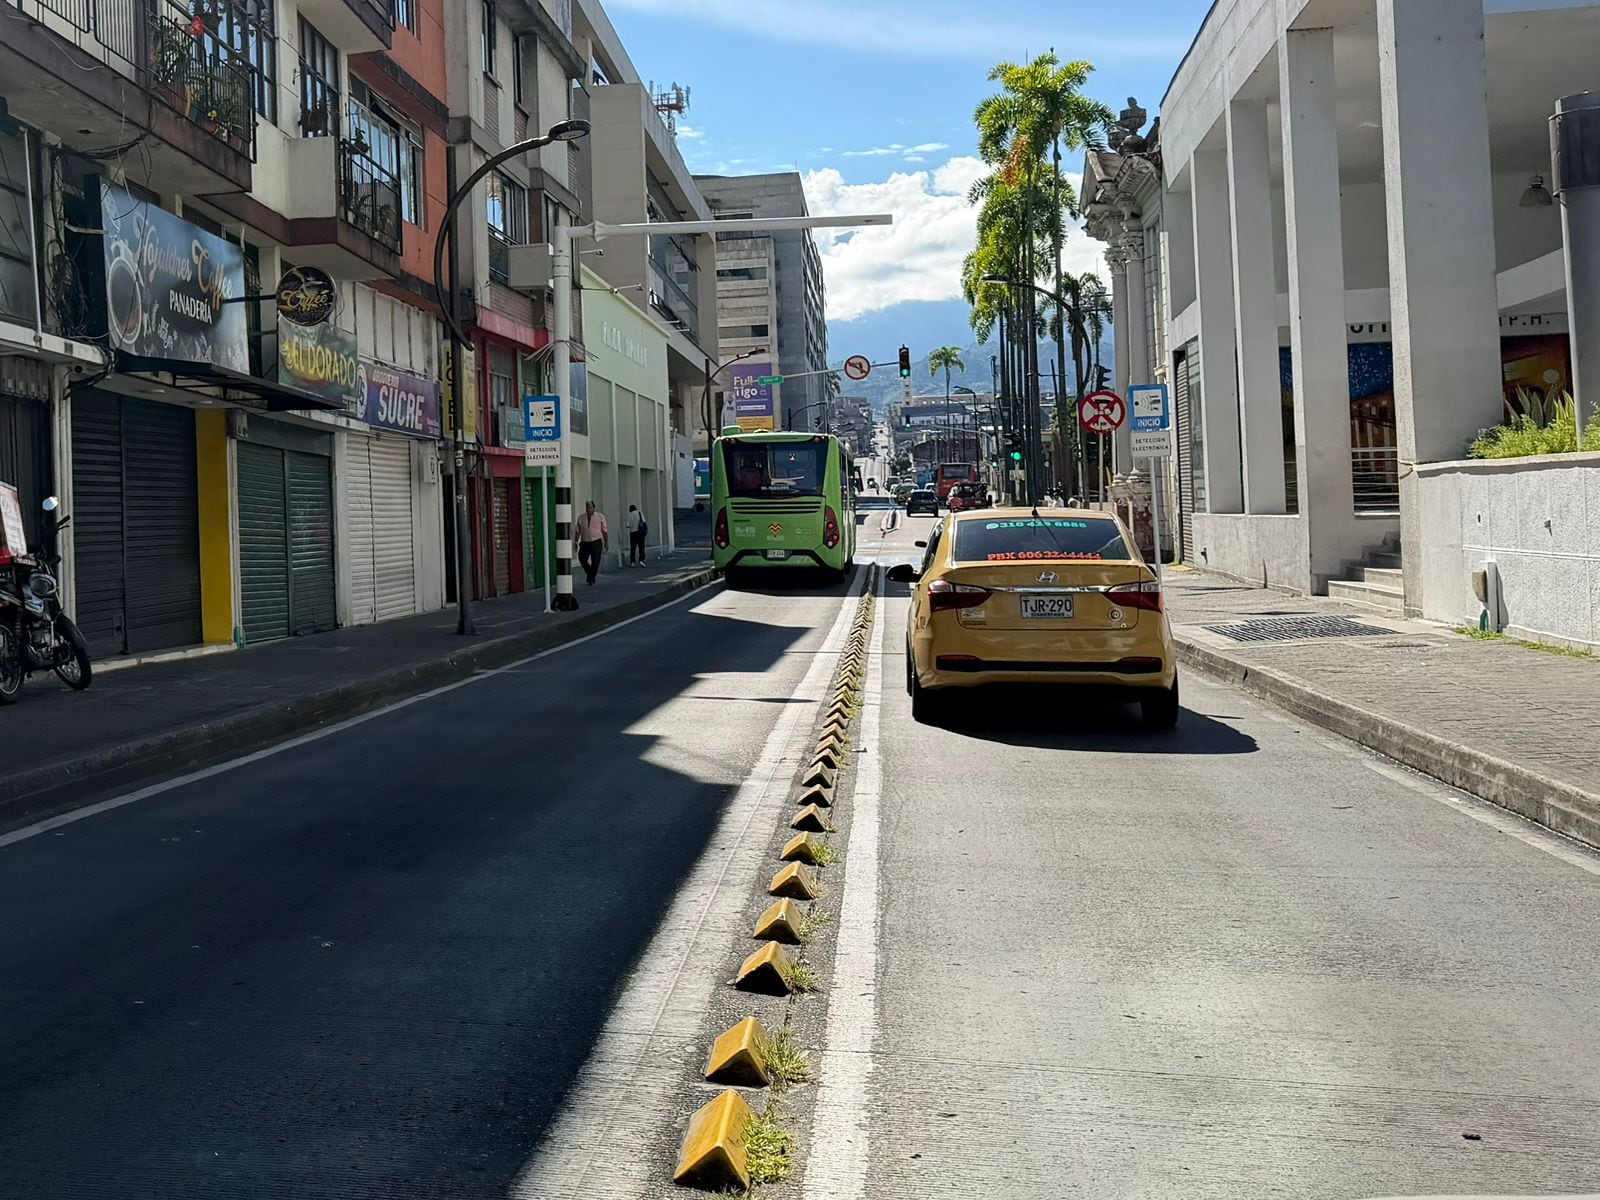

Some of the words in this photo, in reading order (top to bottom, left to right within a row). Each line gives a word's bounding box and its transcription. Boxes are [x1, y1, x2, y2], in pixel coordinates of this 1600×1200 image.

[191, 239, 233, 311] Coffee
[169, 289, 213, 325] PANADERÍA
[292, 334, 305, 373] EL
[307, 340, 358, 390] DORADO
[733, 375, 754, 386] Full
[733, 386, 758, 399] Tigo
[378, 385, 425, 430] SUCRE
[1137, 417, 1161, 427] INICIO
[532, 428, 553, 437] INICIO
[988, 551, 1016, 561] PBX
[1018, 551, 1042, 560] 606
